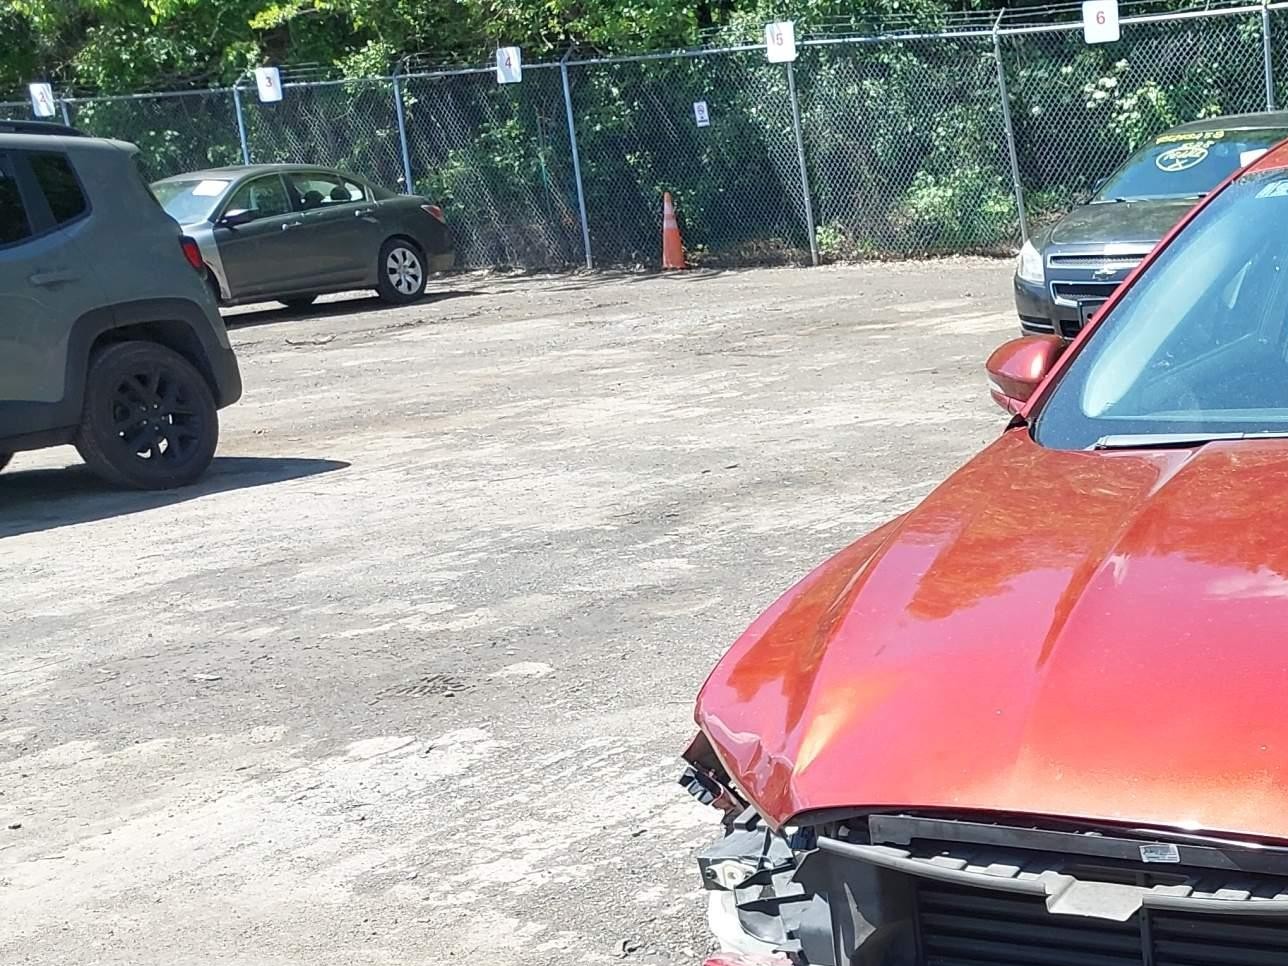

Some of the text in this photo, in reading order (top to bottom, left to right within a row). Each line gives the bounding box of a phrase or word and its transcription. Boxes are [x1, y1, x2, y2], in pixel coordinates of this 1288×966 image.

[1096, 10, 1105, 24] 6
[776, 33, 783, 46] 5
[505, 56, 512, 69] 4
[266, 76, 272, 87] 3
